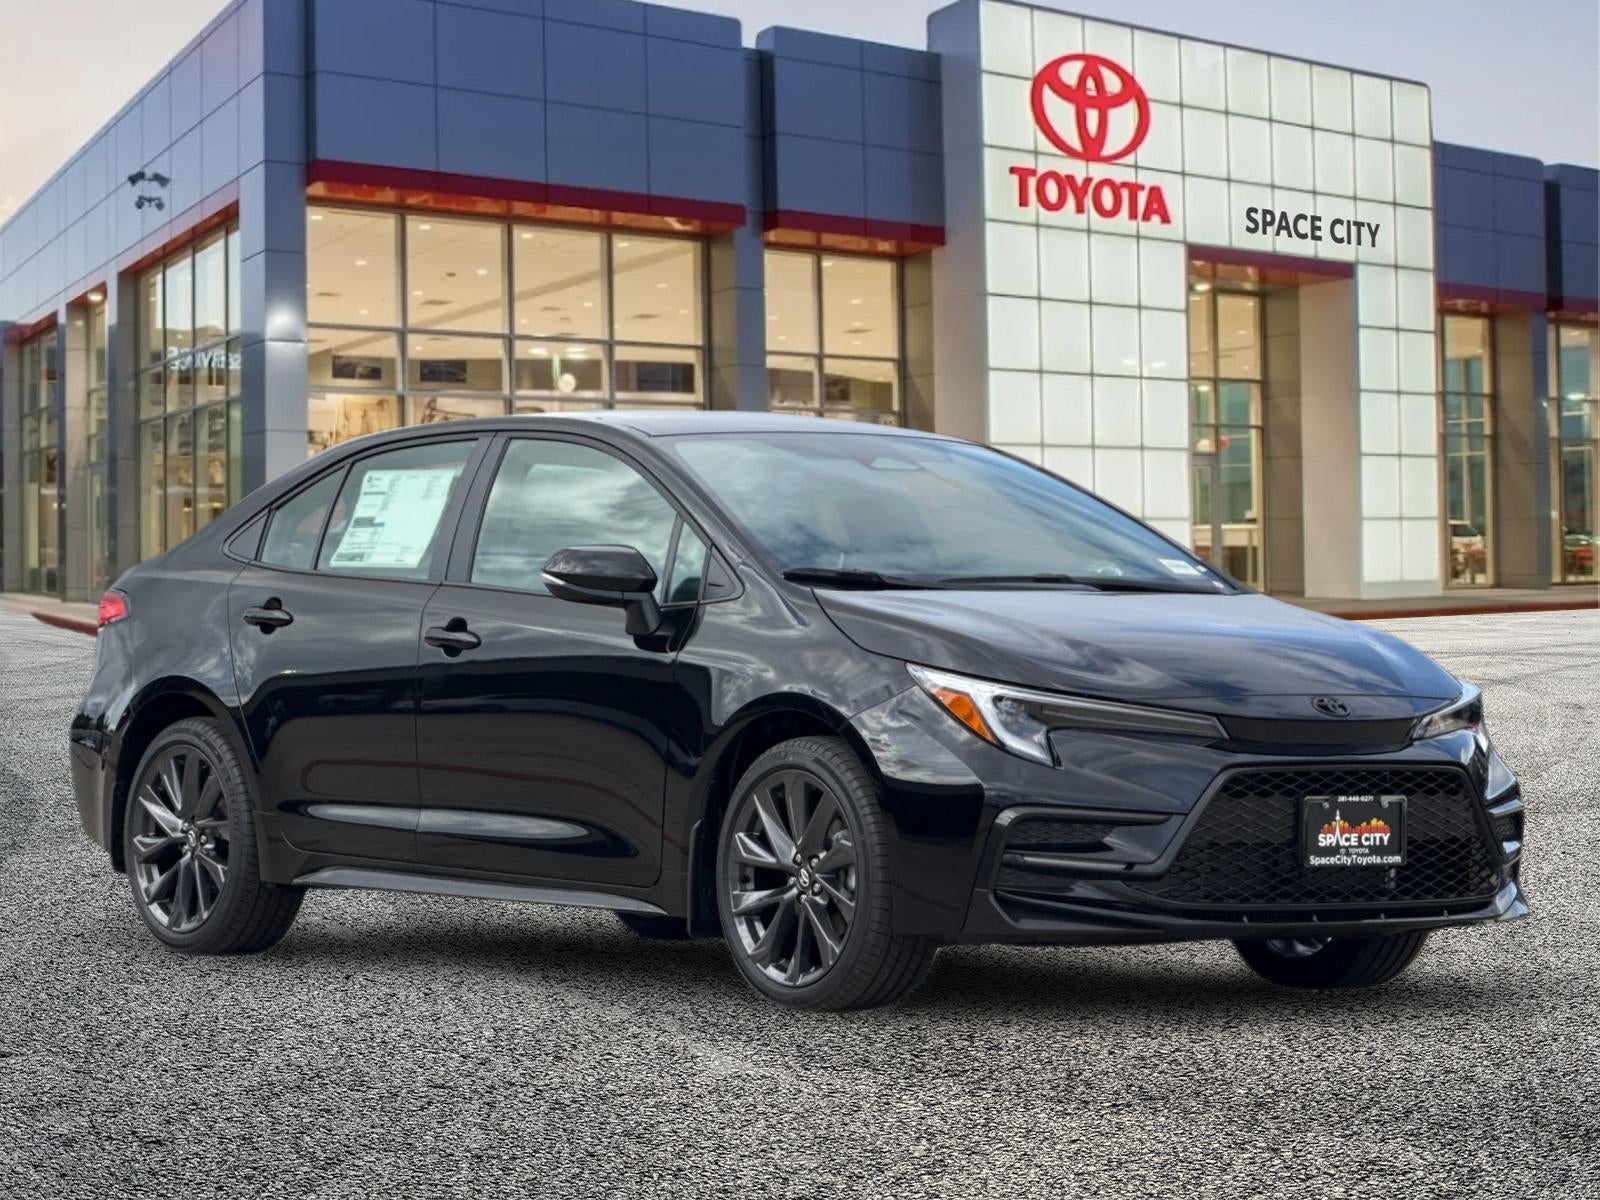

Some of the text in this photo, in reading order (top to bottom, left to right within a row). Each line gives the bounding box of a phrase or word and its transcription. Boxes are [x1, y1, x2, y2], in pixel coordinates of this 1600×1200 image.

[1009, 166, 1171, 225] TOYOTA
[1245, 206, 1381, 248] SPACE CITY
[1318, 833, 1390, 847] SPACE CITY
[1309, 855, 1402, 866] SpaceCityToyota.com
